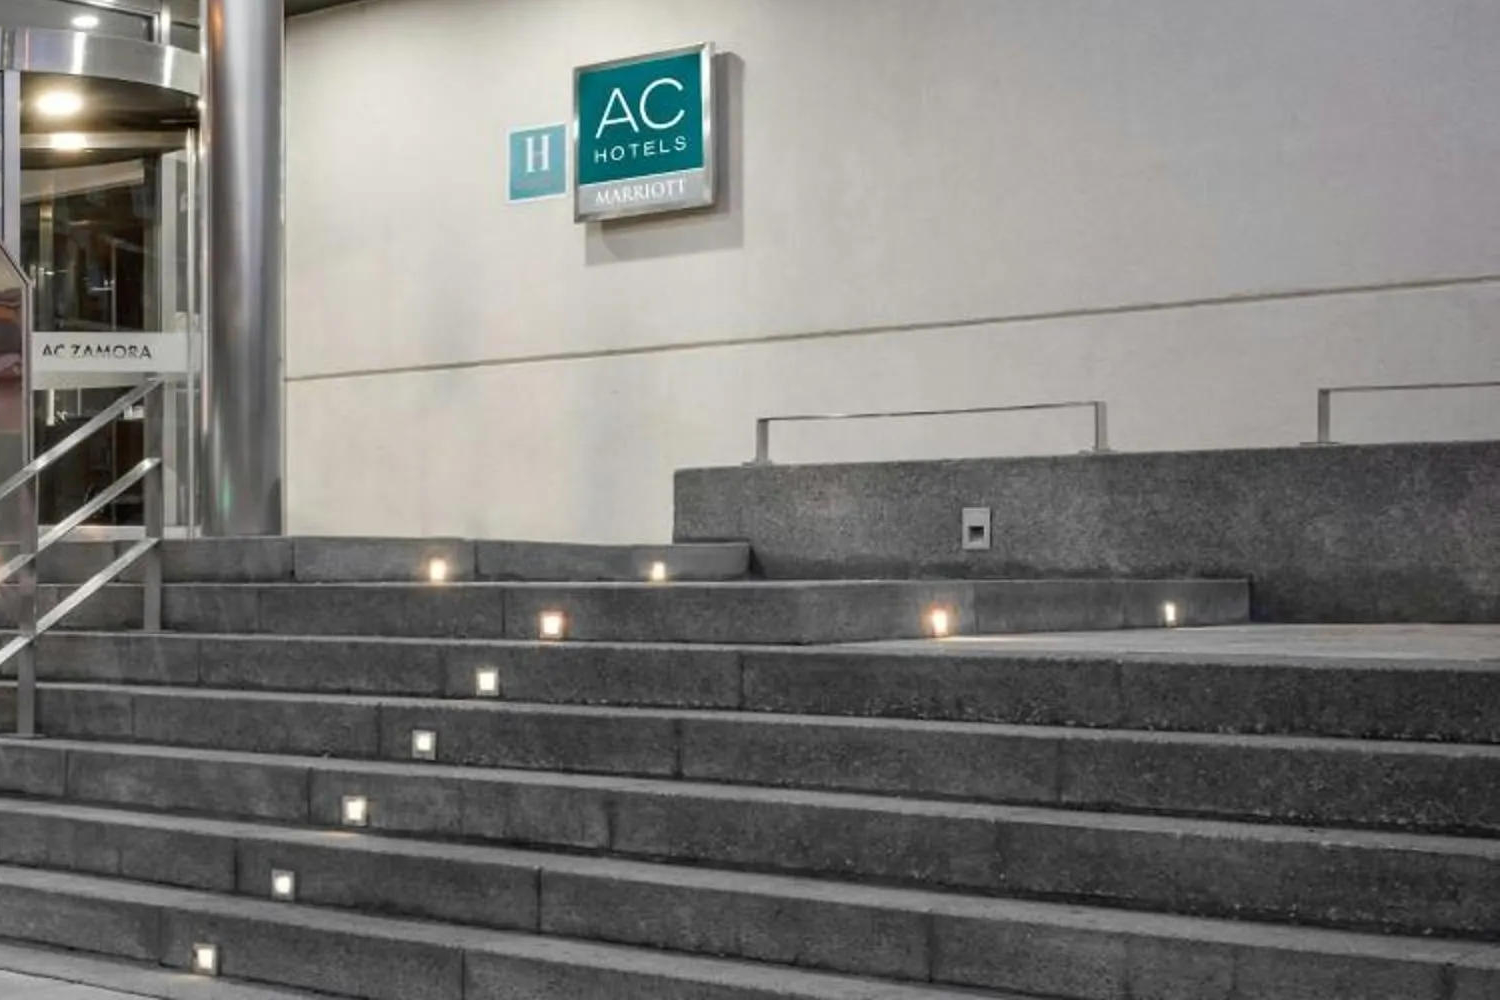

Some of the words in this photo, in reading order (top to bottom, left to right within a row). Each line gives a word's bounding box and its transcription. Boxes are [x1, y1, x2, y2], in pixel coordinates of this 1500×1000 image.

[595, 77, 686, 140] AC
[593, 135, 687, 164] HOTELS
[595, 178, 687, 205] MARRIOTT
[42, 343, 65, 358] AC
[70, 343, 153, 360] ZAMORA
